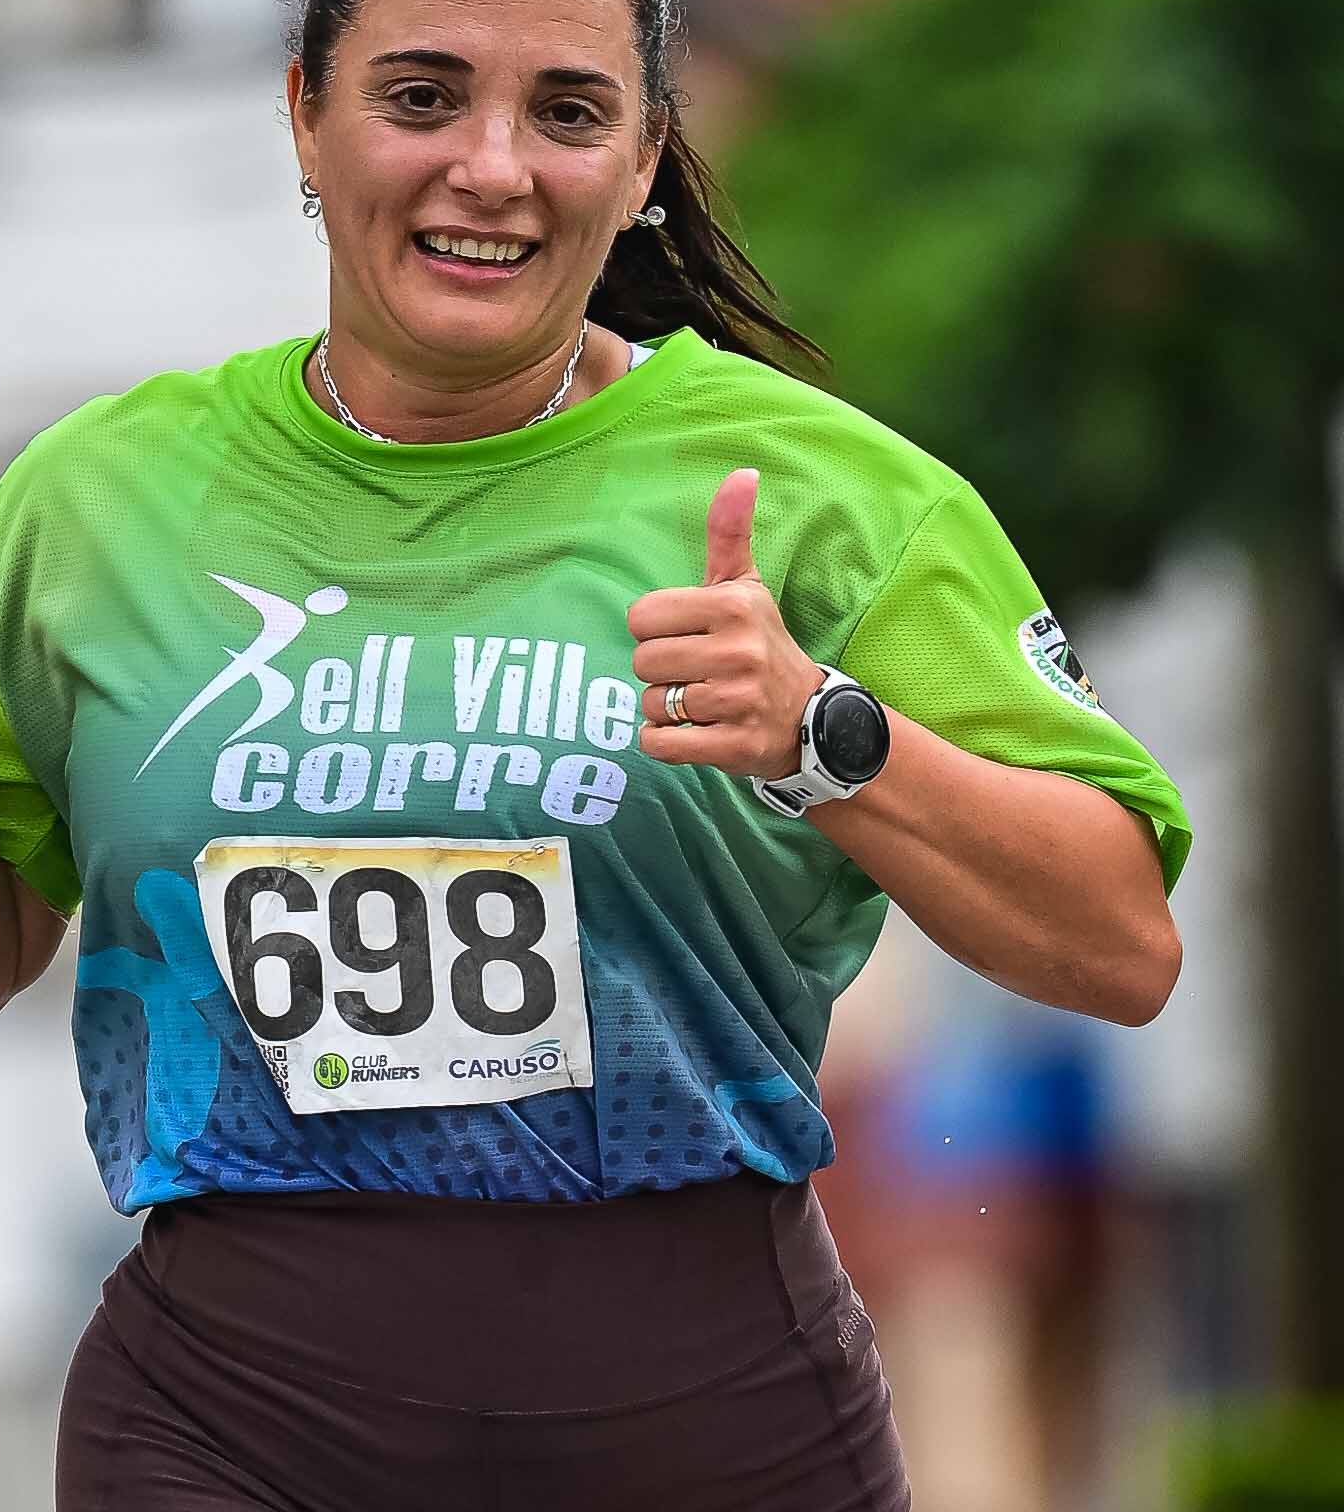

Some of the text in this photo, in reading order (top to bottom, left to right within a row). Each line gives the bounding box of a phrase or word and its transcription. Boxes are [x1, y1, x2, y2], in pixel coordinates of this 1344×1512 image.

[453, 635, 639, 752] Ville
[210, 741, 628, 826] corre
[223, 866, 558, 1042] 698
[352, 1054, 388, 1069] CLUB
[448, 1052, 560, 1080] CARUSO
